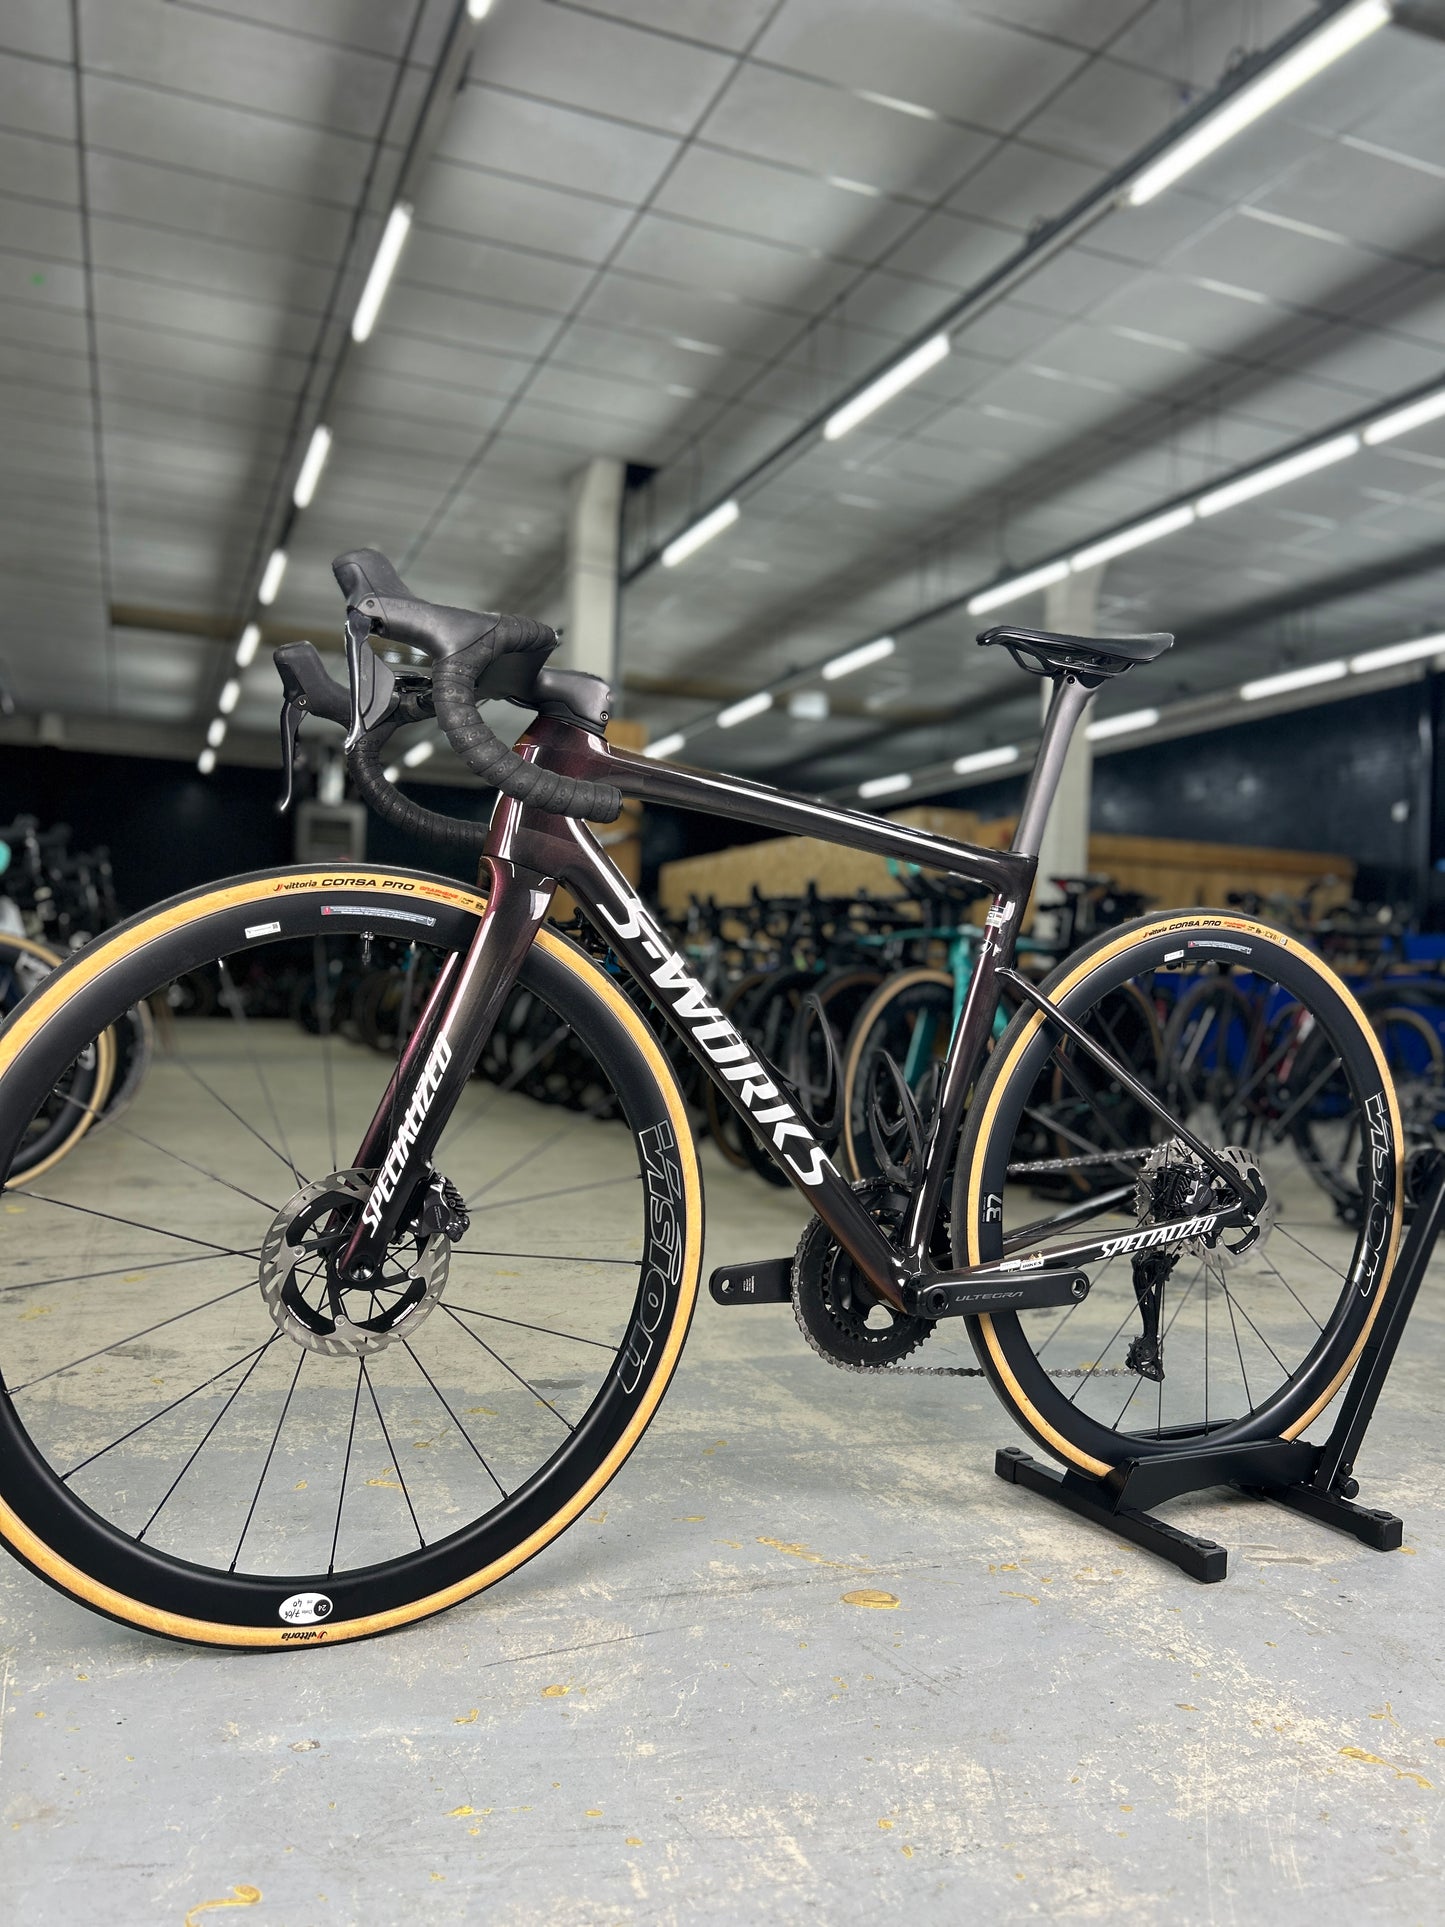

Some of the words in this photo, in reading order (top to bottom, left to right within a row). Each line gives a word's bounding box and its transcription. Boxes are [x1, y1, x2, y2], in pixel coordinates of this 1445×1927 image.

[283, 880, 317, 890] vittoria
[321, 878, 377, 887] CORSA
[382, 880, 415, 891] PRO
[1169, 920, 1200, 931] CORSA
[596, 897, 842, 1186] S-WORKS
[362, 1031, 452, 1238] SPECIALIZED
[986, 1194, 1002, 1222] 37
[1095, 1215, 1218, 1260] SPECIALIZED
[955, 1291, 1024, 1302] ULTEGRA
[318, 1604, 327, 1612] 24
[281, 1631, 317, 1641] vittoria
